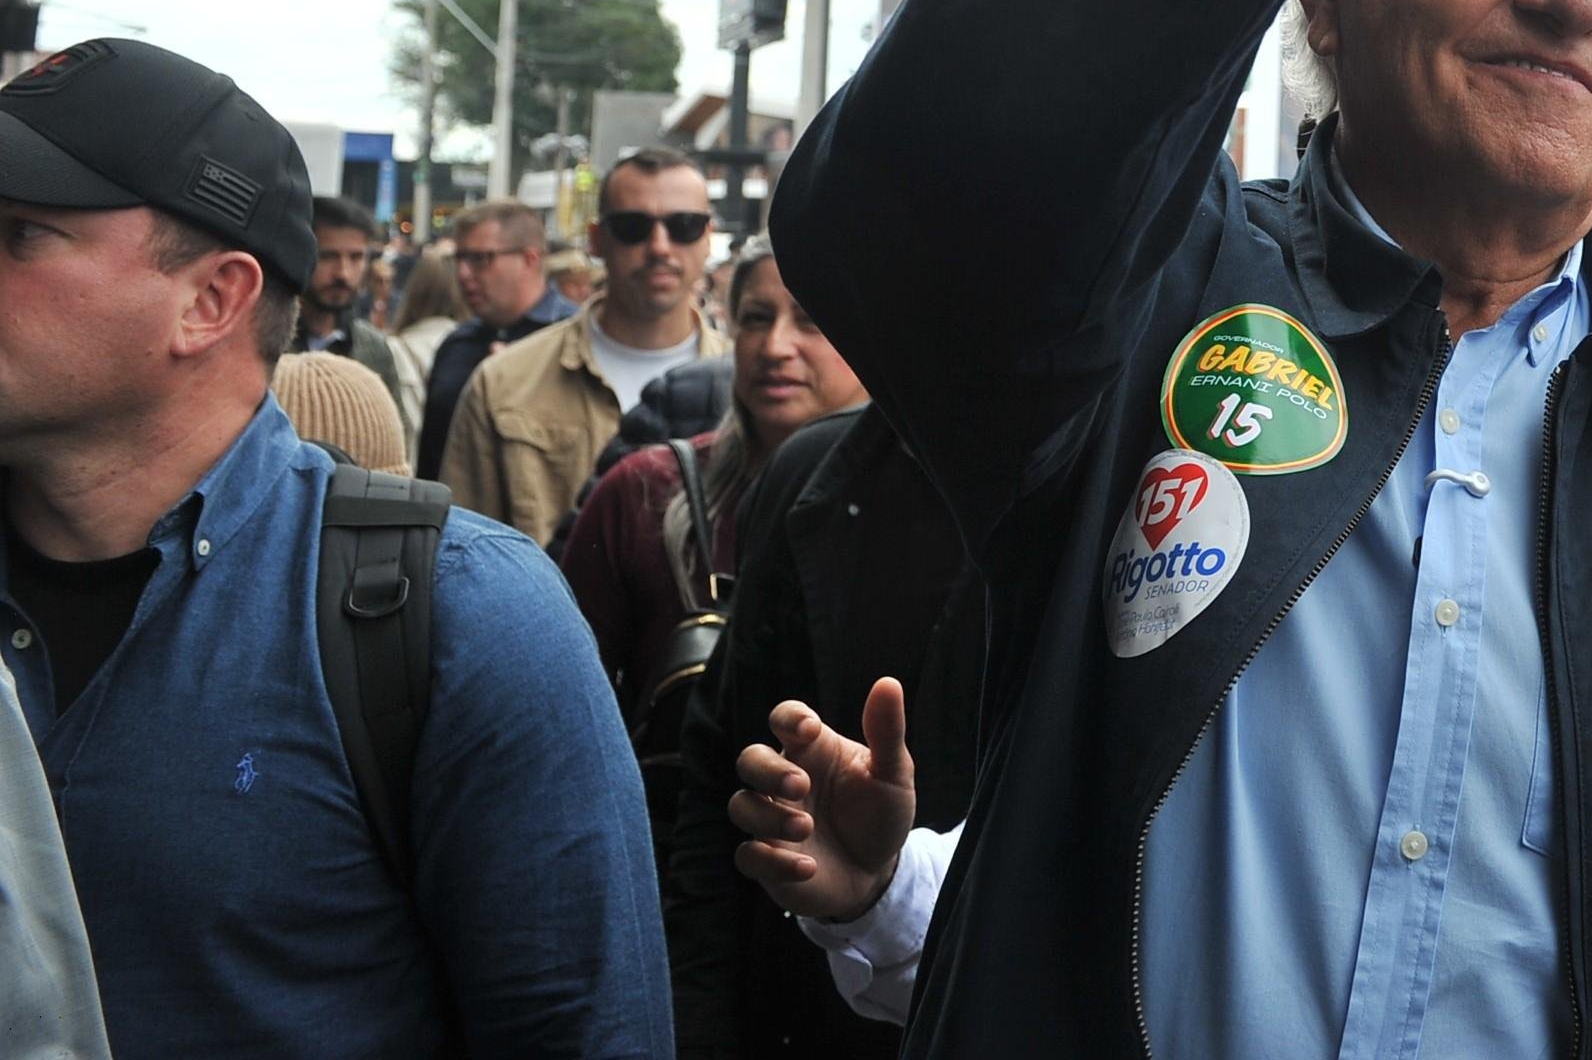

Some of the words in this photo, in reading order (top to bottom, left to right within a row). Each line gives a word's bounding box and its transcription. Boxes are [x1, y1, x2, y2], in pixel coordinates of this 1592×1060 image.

[1191, 375, 1273, 394] ERNANI
[1276, 388, 1328, 420] POLO
[1198, 344, 1334, 411] GABRIEL
[1207, 393, 1273, 448] 15
[1138, 476, 1204, 528] 151
[1108, 541, 1227, 603] Rigotto
[1144, 580, 1209, 600] SENADOR
